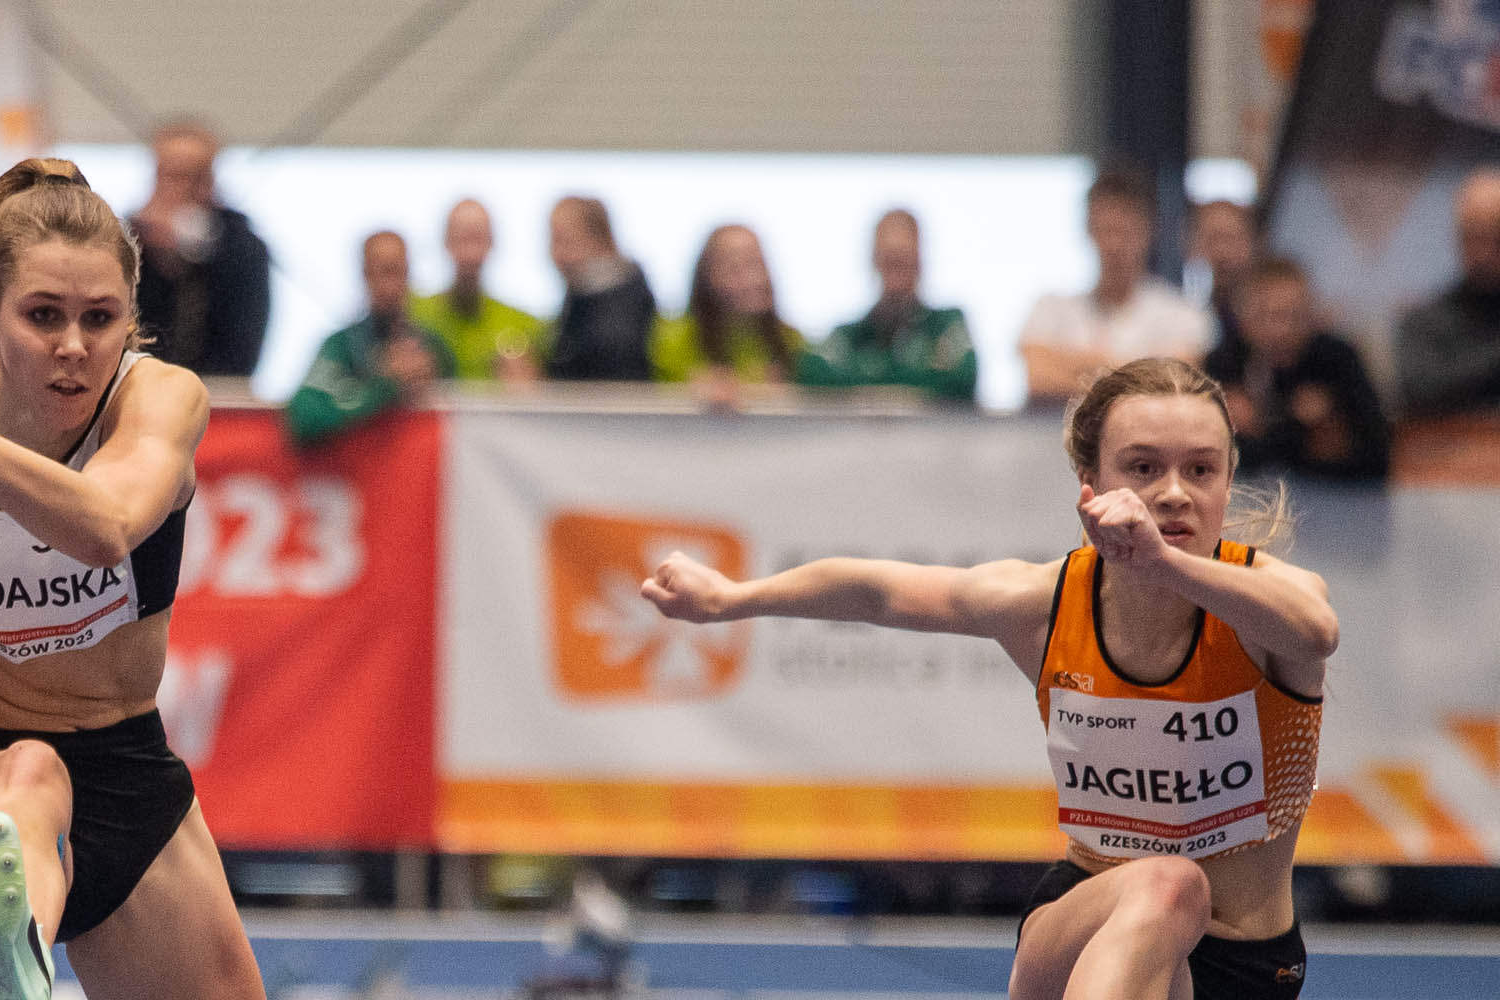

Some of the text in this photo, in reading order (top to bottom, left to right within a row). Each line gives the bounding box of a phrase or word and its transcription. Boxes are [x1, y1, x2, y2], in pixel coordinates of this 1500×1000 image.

[54, 629, 94, 650] 2023
[1057, 707, 1239, 743] TVP SPORT 410
[1065, 760, 1253, 805] JAGIEŁŁO
[1069, 812, 1092, 825] PZLA
[1131, 820, 1189, 837] Mistrzostwa
[1100, 831, 1228, 855] RZESZÓW 2023
